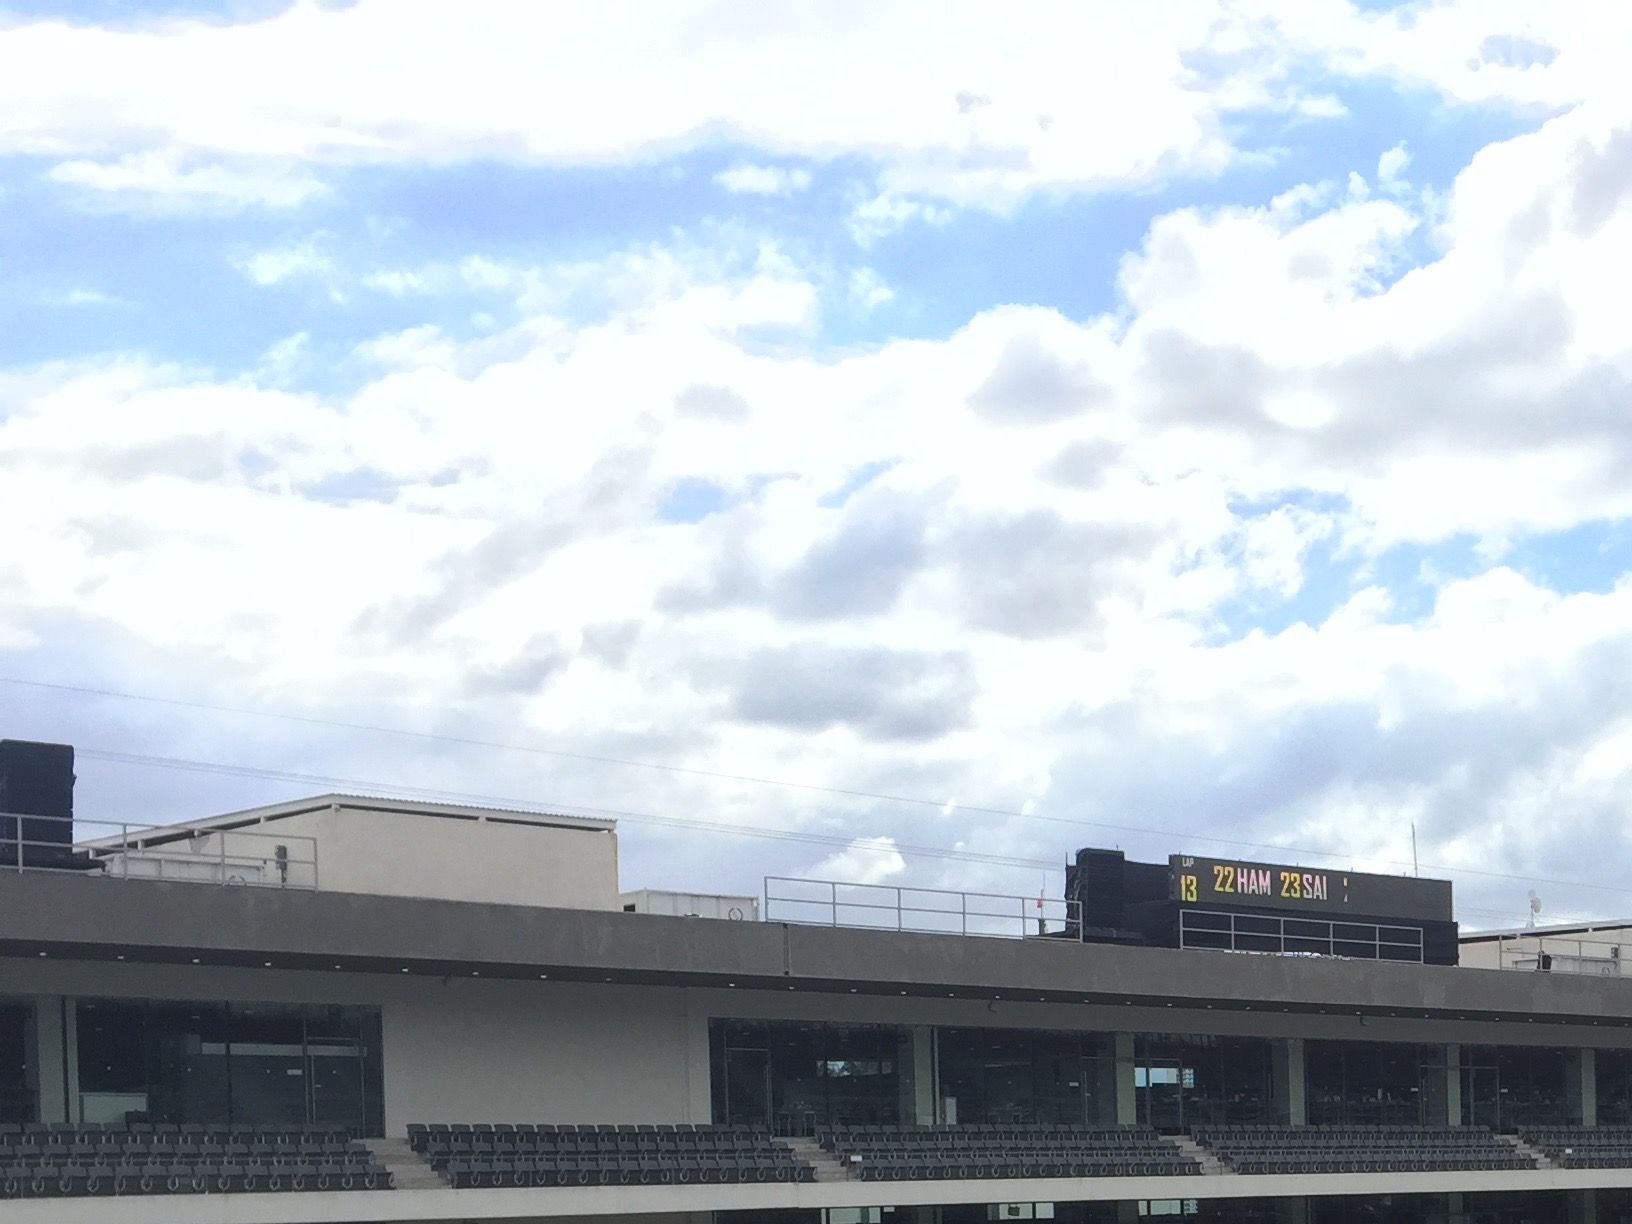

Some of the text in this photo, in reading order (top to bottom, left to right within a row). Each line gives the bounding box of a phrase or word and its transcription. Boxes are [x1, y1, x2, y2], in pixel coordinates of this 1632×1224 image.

[1180, 875, 1197, 902] 13
[1214, 866, 1234, 892] 22
[1237, 868, 1271, 895] HAM
[1280, 872, 1300, 897] 23
[1303, 874, 1327, 900] SAI
